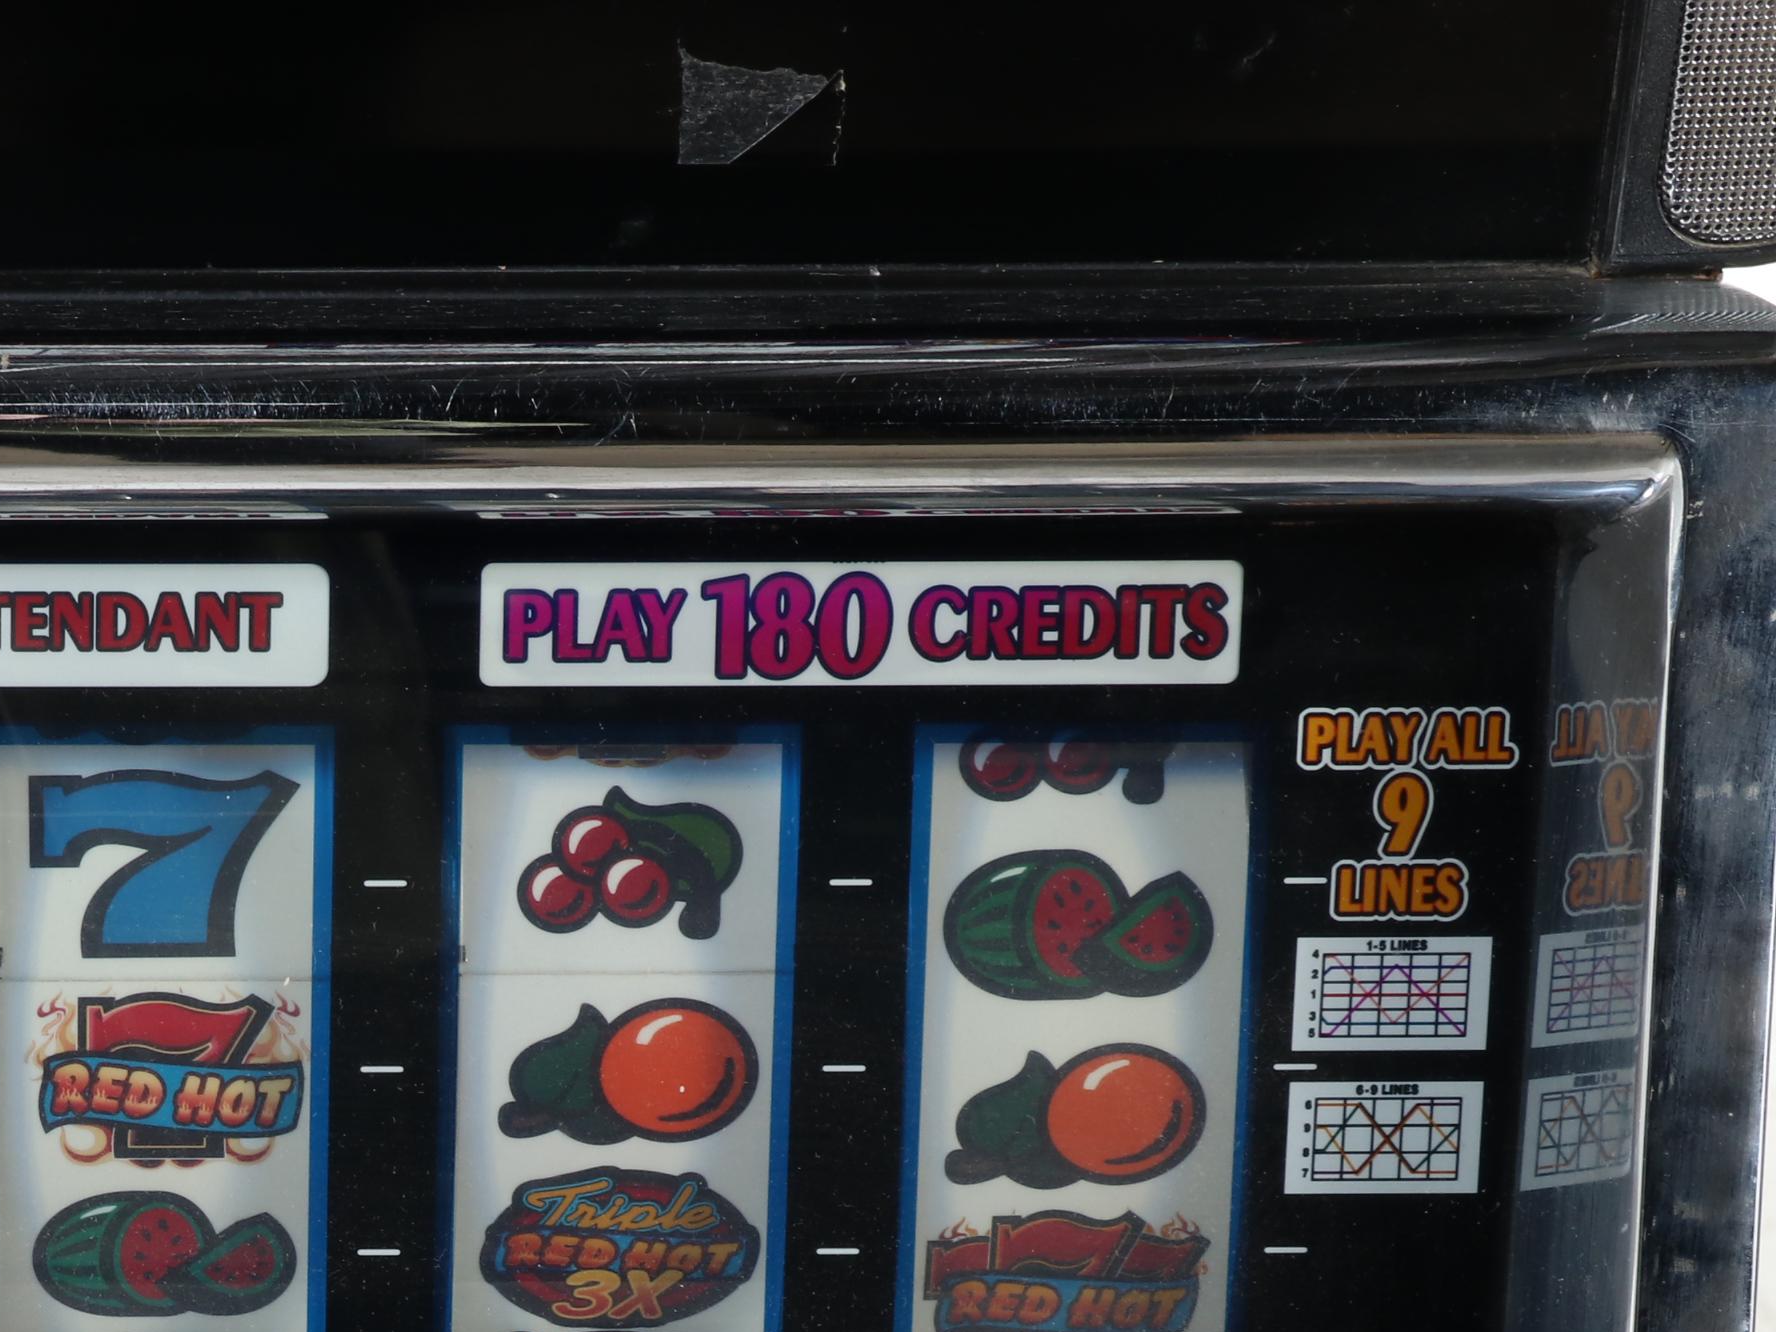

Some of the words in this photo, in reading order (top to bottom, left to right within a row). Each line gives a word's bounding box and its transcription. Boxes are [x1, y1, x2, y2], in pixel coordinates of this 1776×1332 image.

[504, 588, 686, 662] PLAY
[701, 571, 893, 679] 180
[909, 583, 1228, 661] CREDITS
[1298, 708, 1425, 769] PLAY
[1420, 708, 1519, 769] ALL
[1373, 767, 1434, 860] 9
[29, 769, 301, 958] 7
[1330, 859, 1469, 921] LINES
[1312, 949, 1320, 959] 4
[1391, 940, 1428, 951] LINES
[1311, 970, 1319, 979] 2
[49, 1061, 166, 1119] RED
[172, 1071, 294, 1128] HOT
[1381, 1084, 1419, 1095] LINES
[524, 1177, 720, 1233] Triple
[504, 1233, 618, 1270] RED
[622, 1240, 740, 1277] HOT
[551, 1269, 684, 1320] 3X
[947, 1279, 1062, 1326] RED
[1067, 1285, 1188, 1330] HOT
